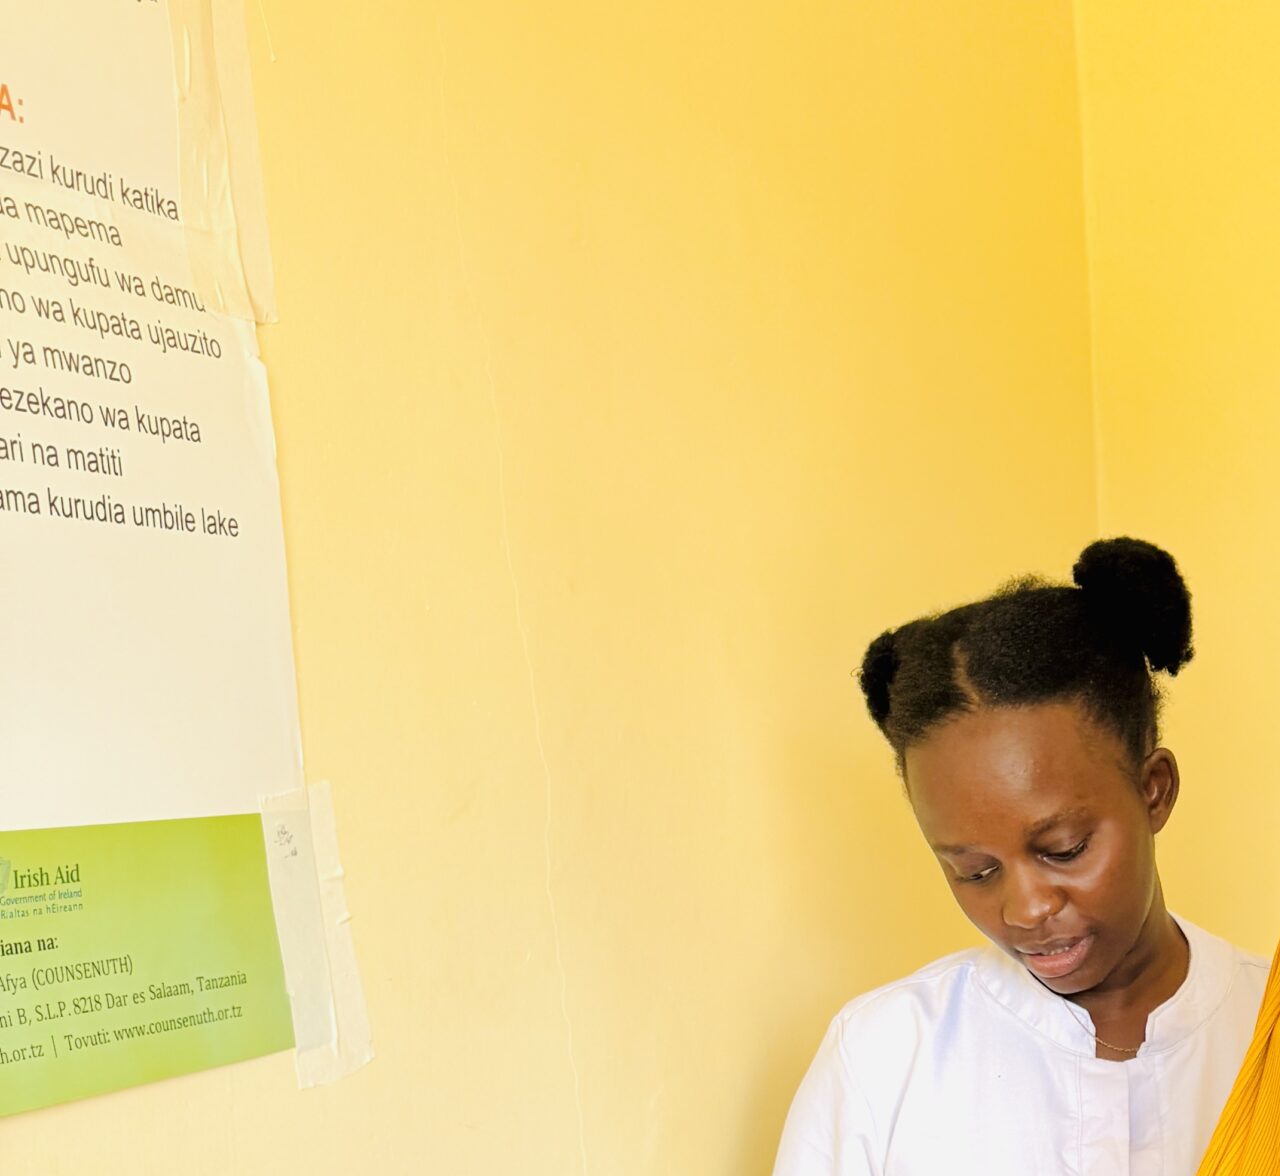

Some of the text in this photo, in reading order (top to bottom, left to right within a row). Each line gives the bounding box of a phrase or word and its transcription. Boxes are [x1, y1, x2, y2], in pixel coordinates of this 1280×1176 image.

[50, 155, 115, 202] kurudi
[120, 178, 179, 221] katika
[0, 196, 122, 247] a mapema
[5, 242, 206, 312] upungufu wa damu
[31, 296, 65, 323] wa
[70, 298, 142, 340] kupata
[148, 320, 222, 359] ujauzito
[7, 339, 132, 384] ya mwanzo
[0, 387, 202, 443] ezekano wa kupata
[31, 442, 60, 467] na
[66, 447, 123, 477] matiti
[47, 487, 126, 524] kurudia
[132, 503, 196, 533] umbile
[201, 507, 239, 538] lake
[0, 888, 82, 906] Government of Ireland
[13, 863, 81, 889] Irish Aid
[0, 908, 29, 919] Rialtas
[33, 907, 43, 916] na
[0, 937, 59, 957] iana na:
[32, 954, 133, 991] (COUNSENUTH)
[17, 1008, 32, 1026] B,
[35, 1001, 71, 1022] S.L.P.
[73, 995, 103, 1016] 8218
[105, 992, 128, 1010] Dar
[133, 992, 146, 1005] es
[148, 982, 194, 1001] Salaam,
[196, 970, 248, 992] Tanzania
[64, 1028, 111, 1051] Tovuti:
[113, 1004, 243, 1041] www.counsenuth.or.tz
